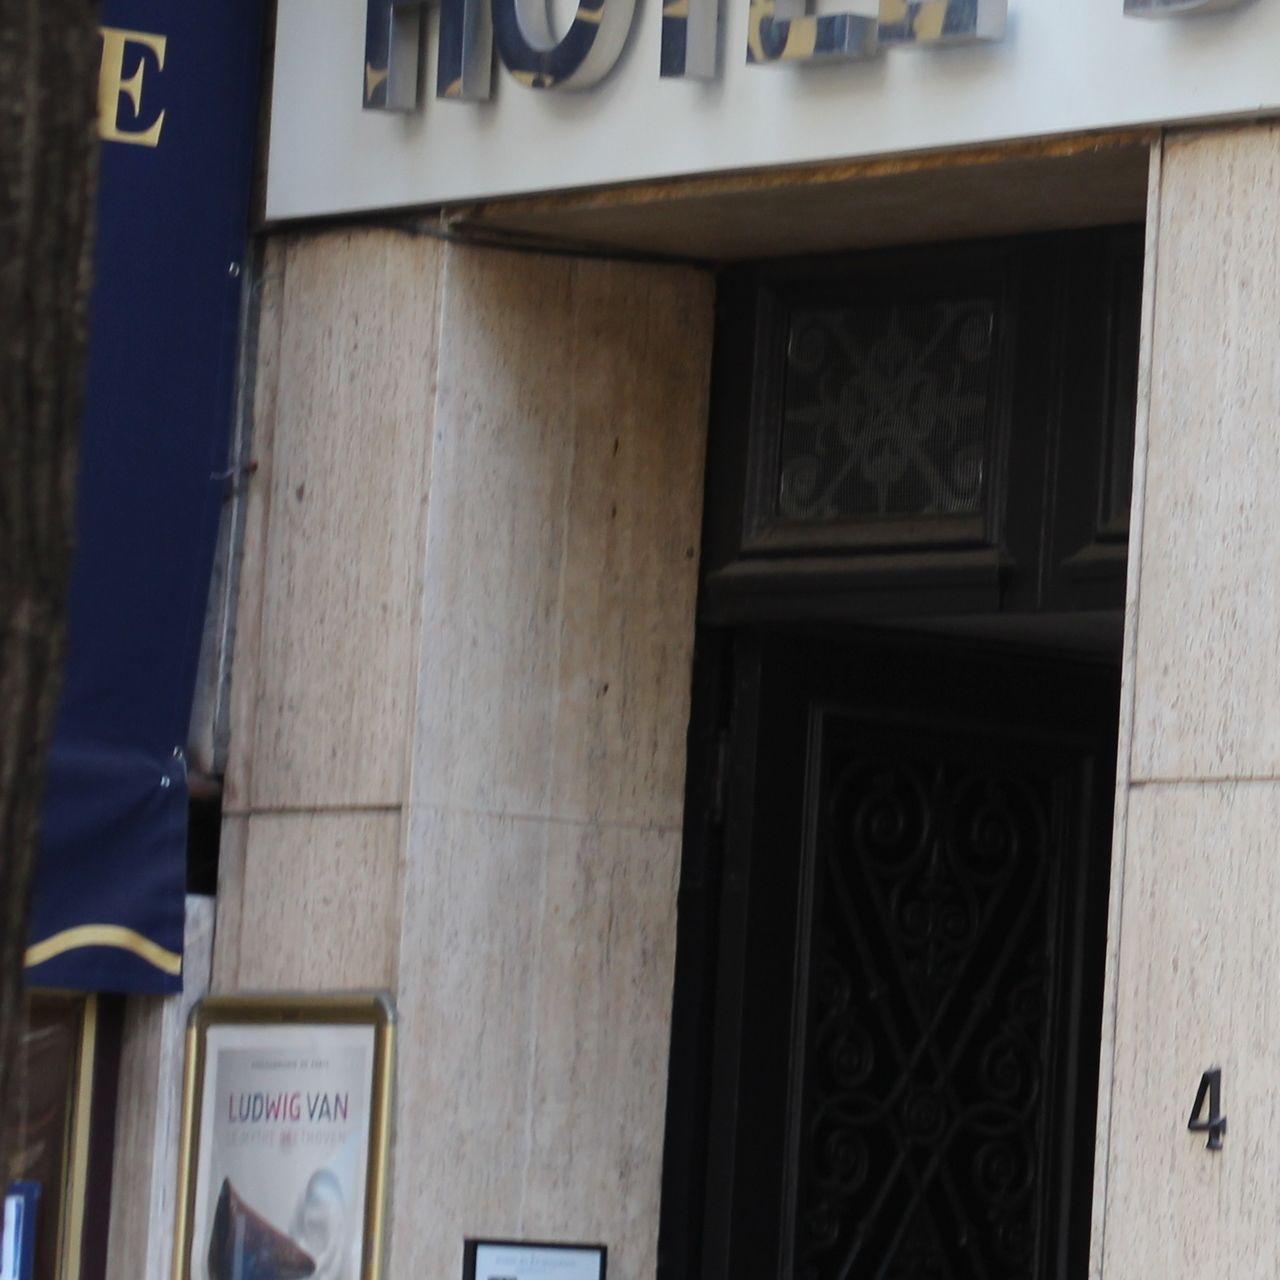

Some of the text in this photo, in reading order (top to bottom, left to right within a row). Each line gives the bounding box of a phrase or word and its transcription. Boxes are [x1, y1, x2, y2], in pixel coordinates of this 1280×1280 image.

[228, 1091, 349, 1123] LUDWIG VAN
[1187, 1064, 1227, 1150] 4
